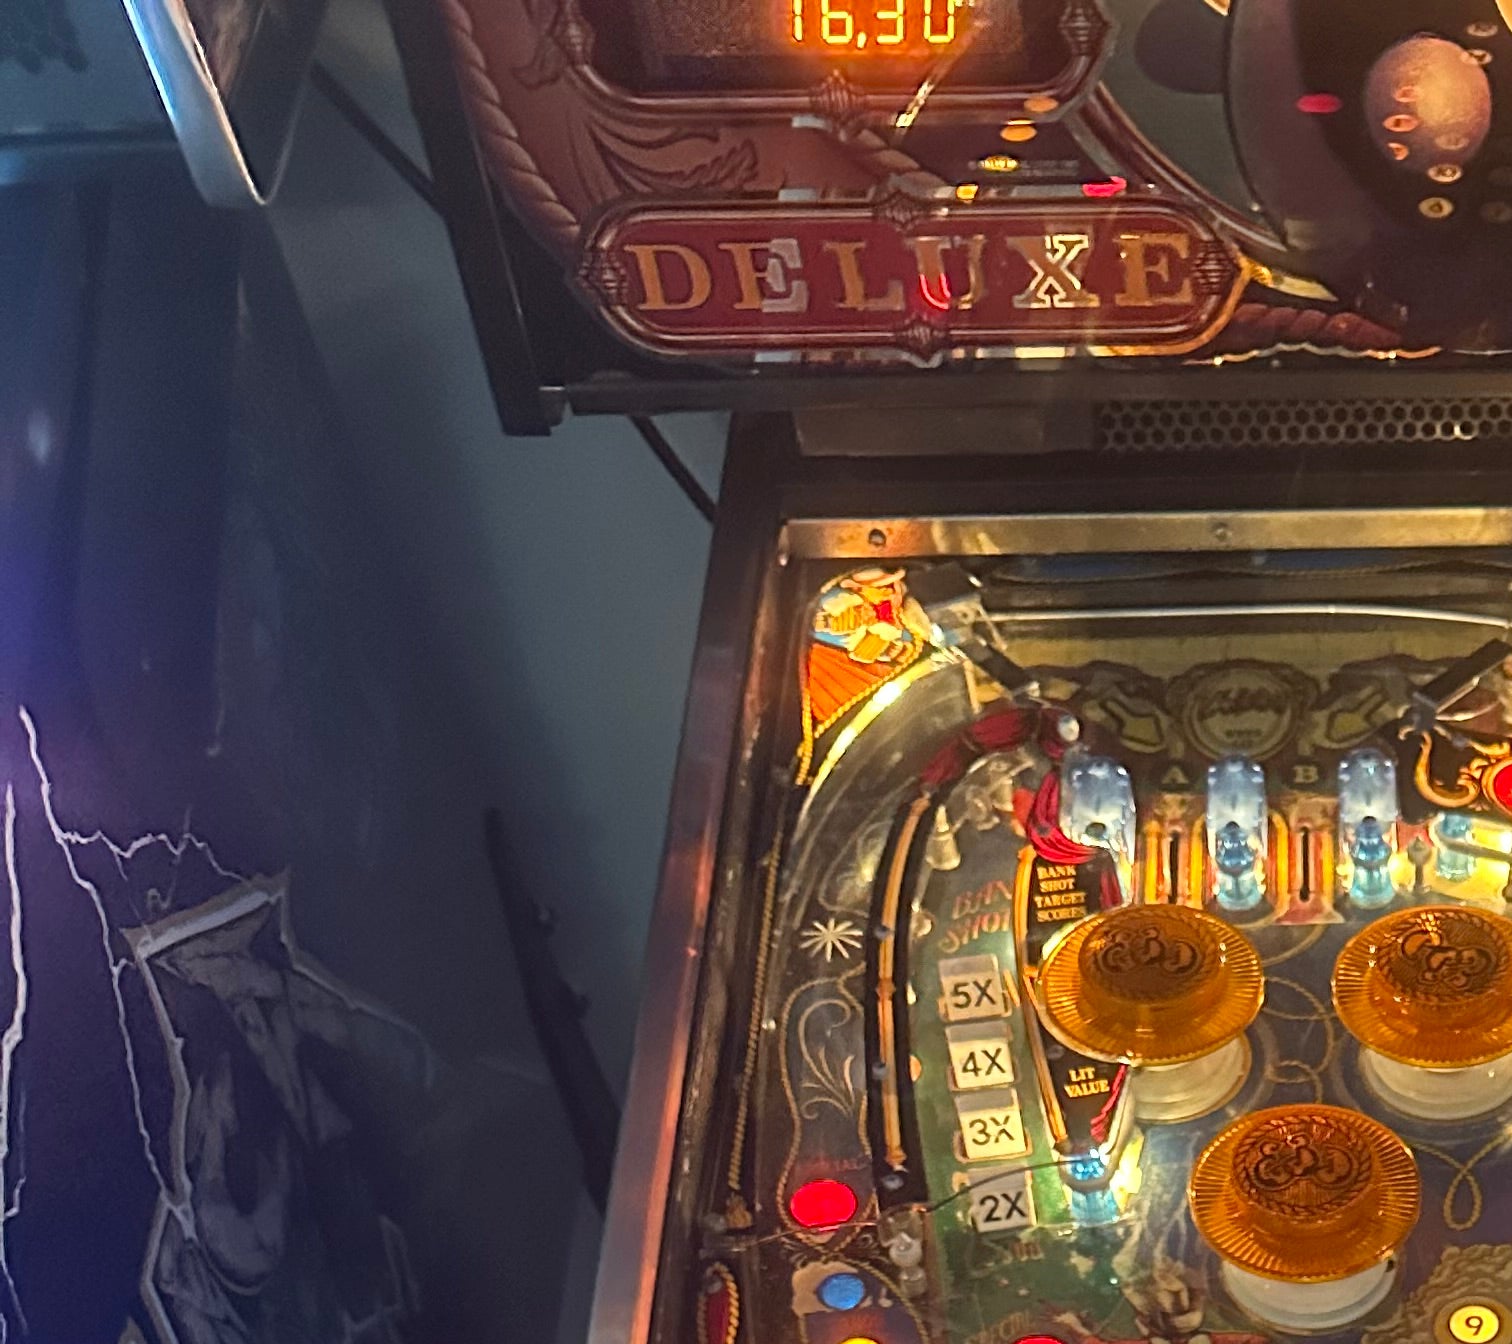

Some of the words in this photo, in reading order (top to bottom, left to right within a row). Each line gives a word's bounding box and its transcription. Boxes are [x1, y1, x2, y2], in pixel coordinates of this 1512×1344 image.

[624, 233, 1192, 312] DELUXE
[1161, 766, 1189, 785] A
[1292, 765, 1320, 784] B
[1036, 865, 1077, 880] BANK
[1039, 878, 1076, 893] SHOT
[1034, 893, 1086, 908] TARGET
[952, 978, 996, 1010] 5X
[961, 1048, 1006, 1077] 4X
[1069, 1067, 1096, 1082] LIT
[1064, 1079, 1110, 1098] VALUE
[968, 1114, 1015, 1146] 3X
[979, 1190, 1027, 1222] 2X
[1465, 1315, 1484, 1336] 9
